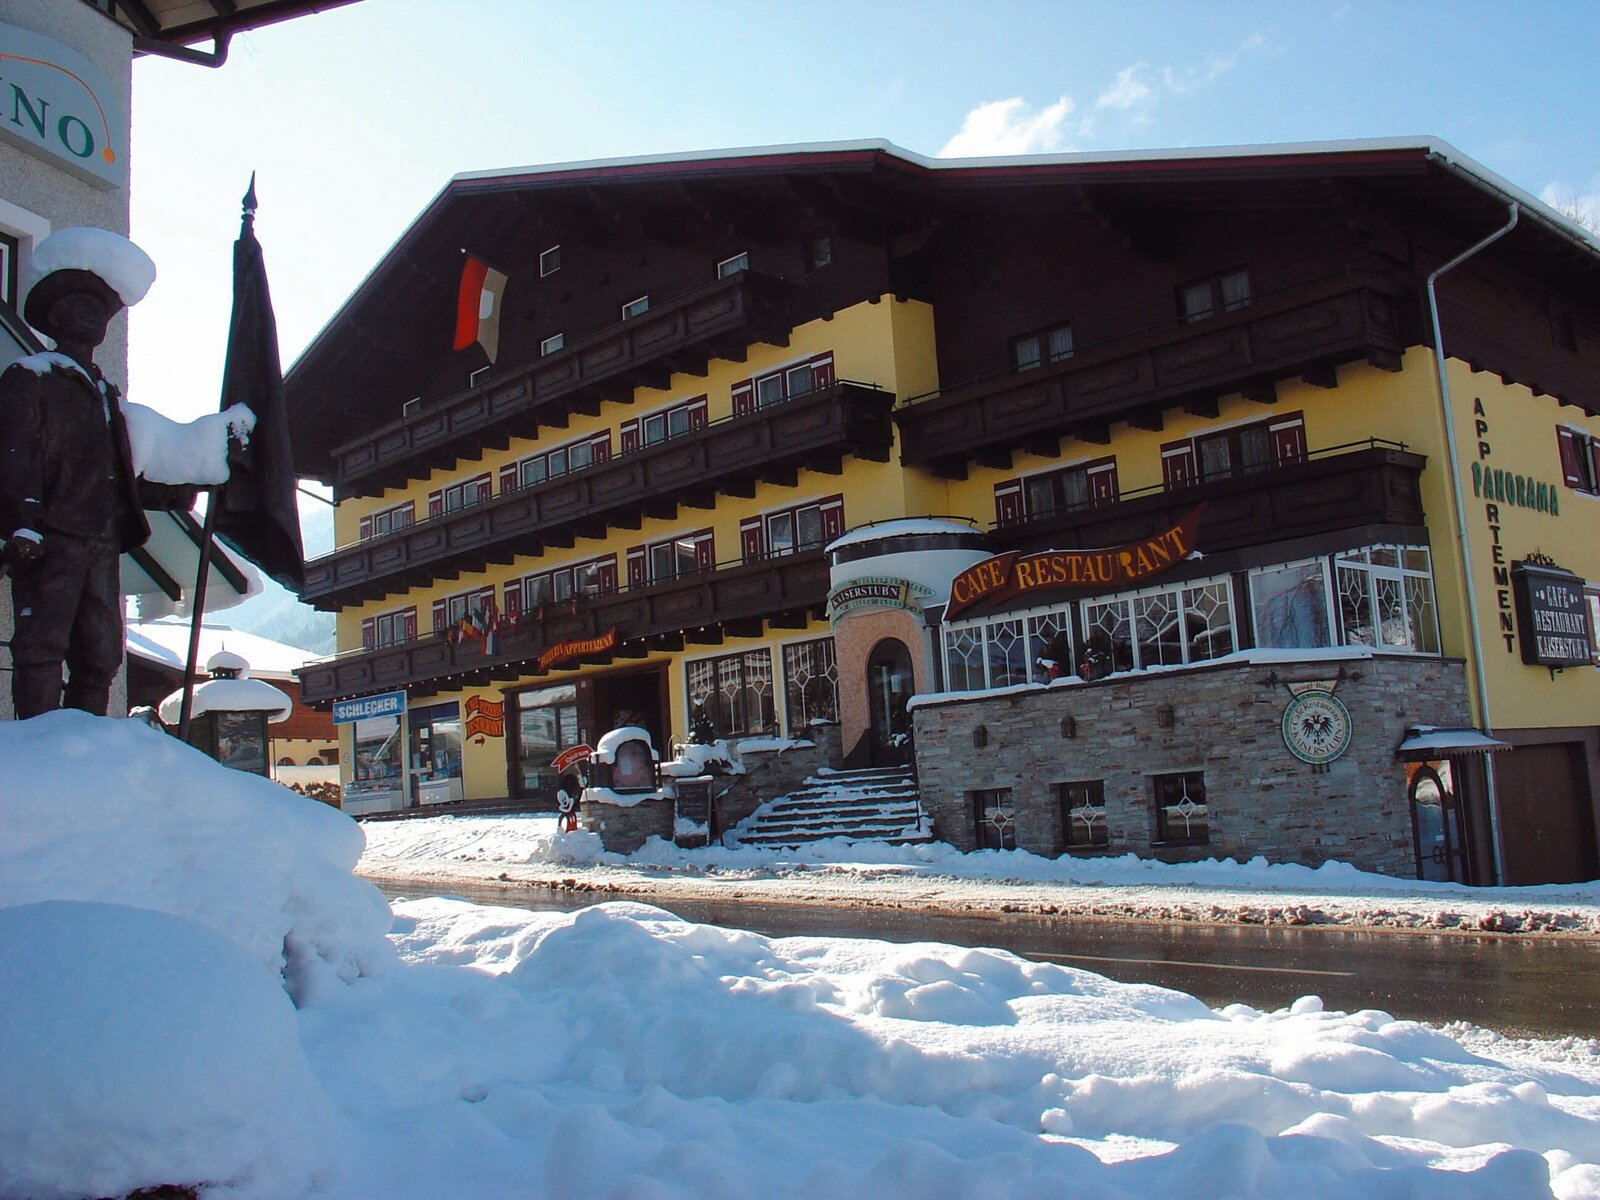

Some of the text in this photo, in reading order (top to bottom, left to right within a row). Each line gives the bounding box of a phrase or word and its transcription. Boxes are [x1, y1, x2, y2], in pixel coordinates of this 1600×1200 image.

[0, 77, 95, 158] NO
[1471, 461, 1559, 517] PANORAMA
[953, 526, 1187, 603] CAFE RESTAURANT
[1546, 585, 1569, 608] CAFE
[1534, 609, 1585, 634] RESTAURANT
[338, 697, 398, 719] SCHLECKER
